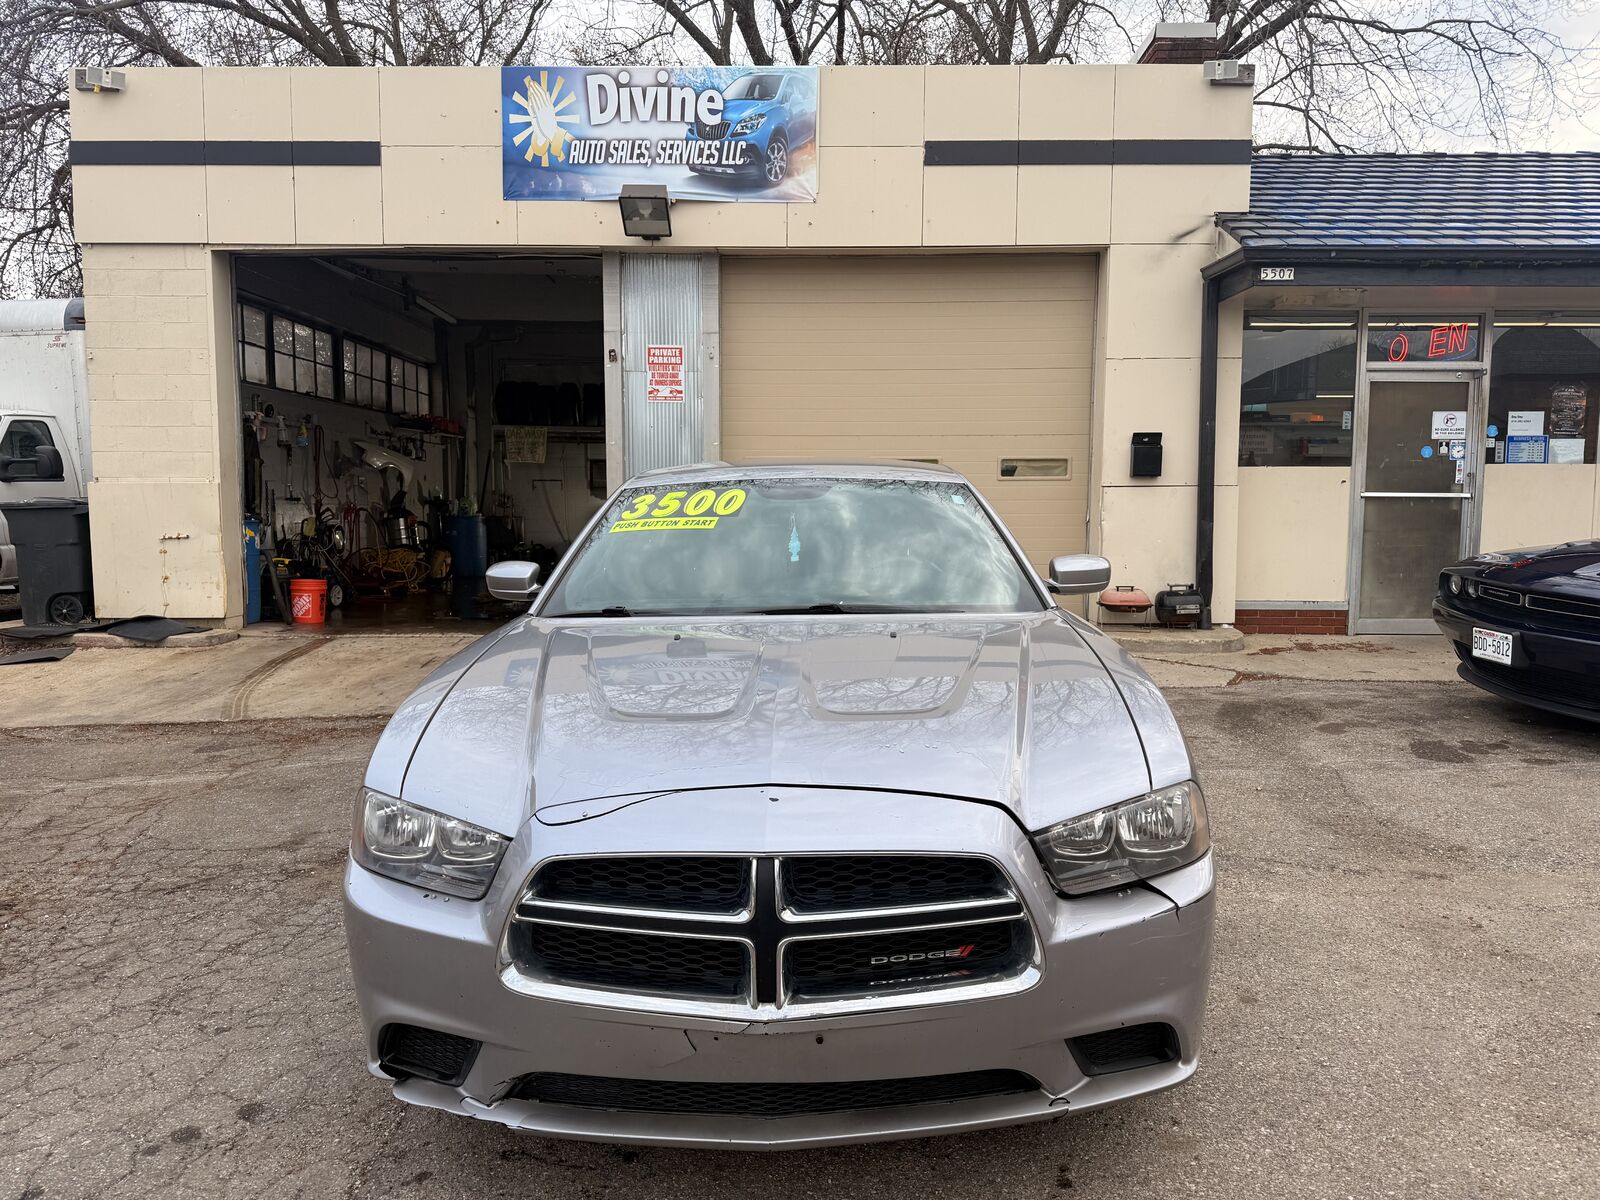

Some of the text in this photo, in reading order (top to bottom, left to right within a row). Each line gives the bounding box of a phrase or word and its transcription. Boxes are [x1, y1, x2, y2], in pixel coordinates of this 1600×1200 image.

[586, 70, 724, 126] Divine
[569, 140, 747, 167] AUTO SALES, SERVICES LLC
[1262, 268, 1293, 279] 5507
[1388, 322, 1469, 362] OEN
[649, 356, 681, 364] PARKING
[650, 348, 681, 356] PRIVATE
[621, 488, 746, 520] 3500
[613, 519, 715, 530] PUSH BUTTON START
[870, 948, 961, 965] DODGE
